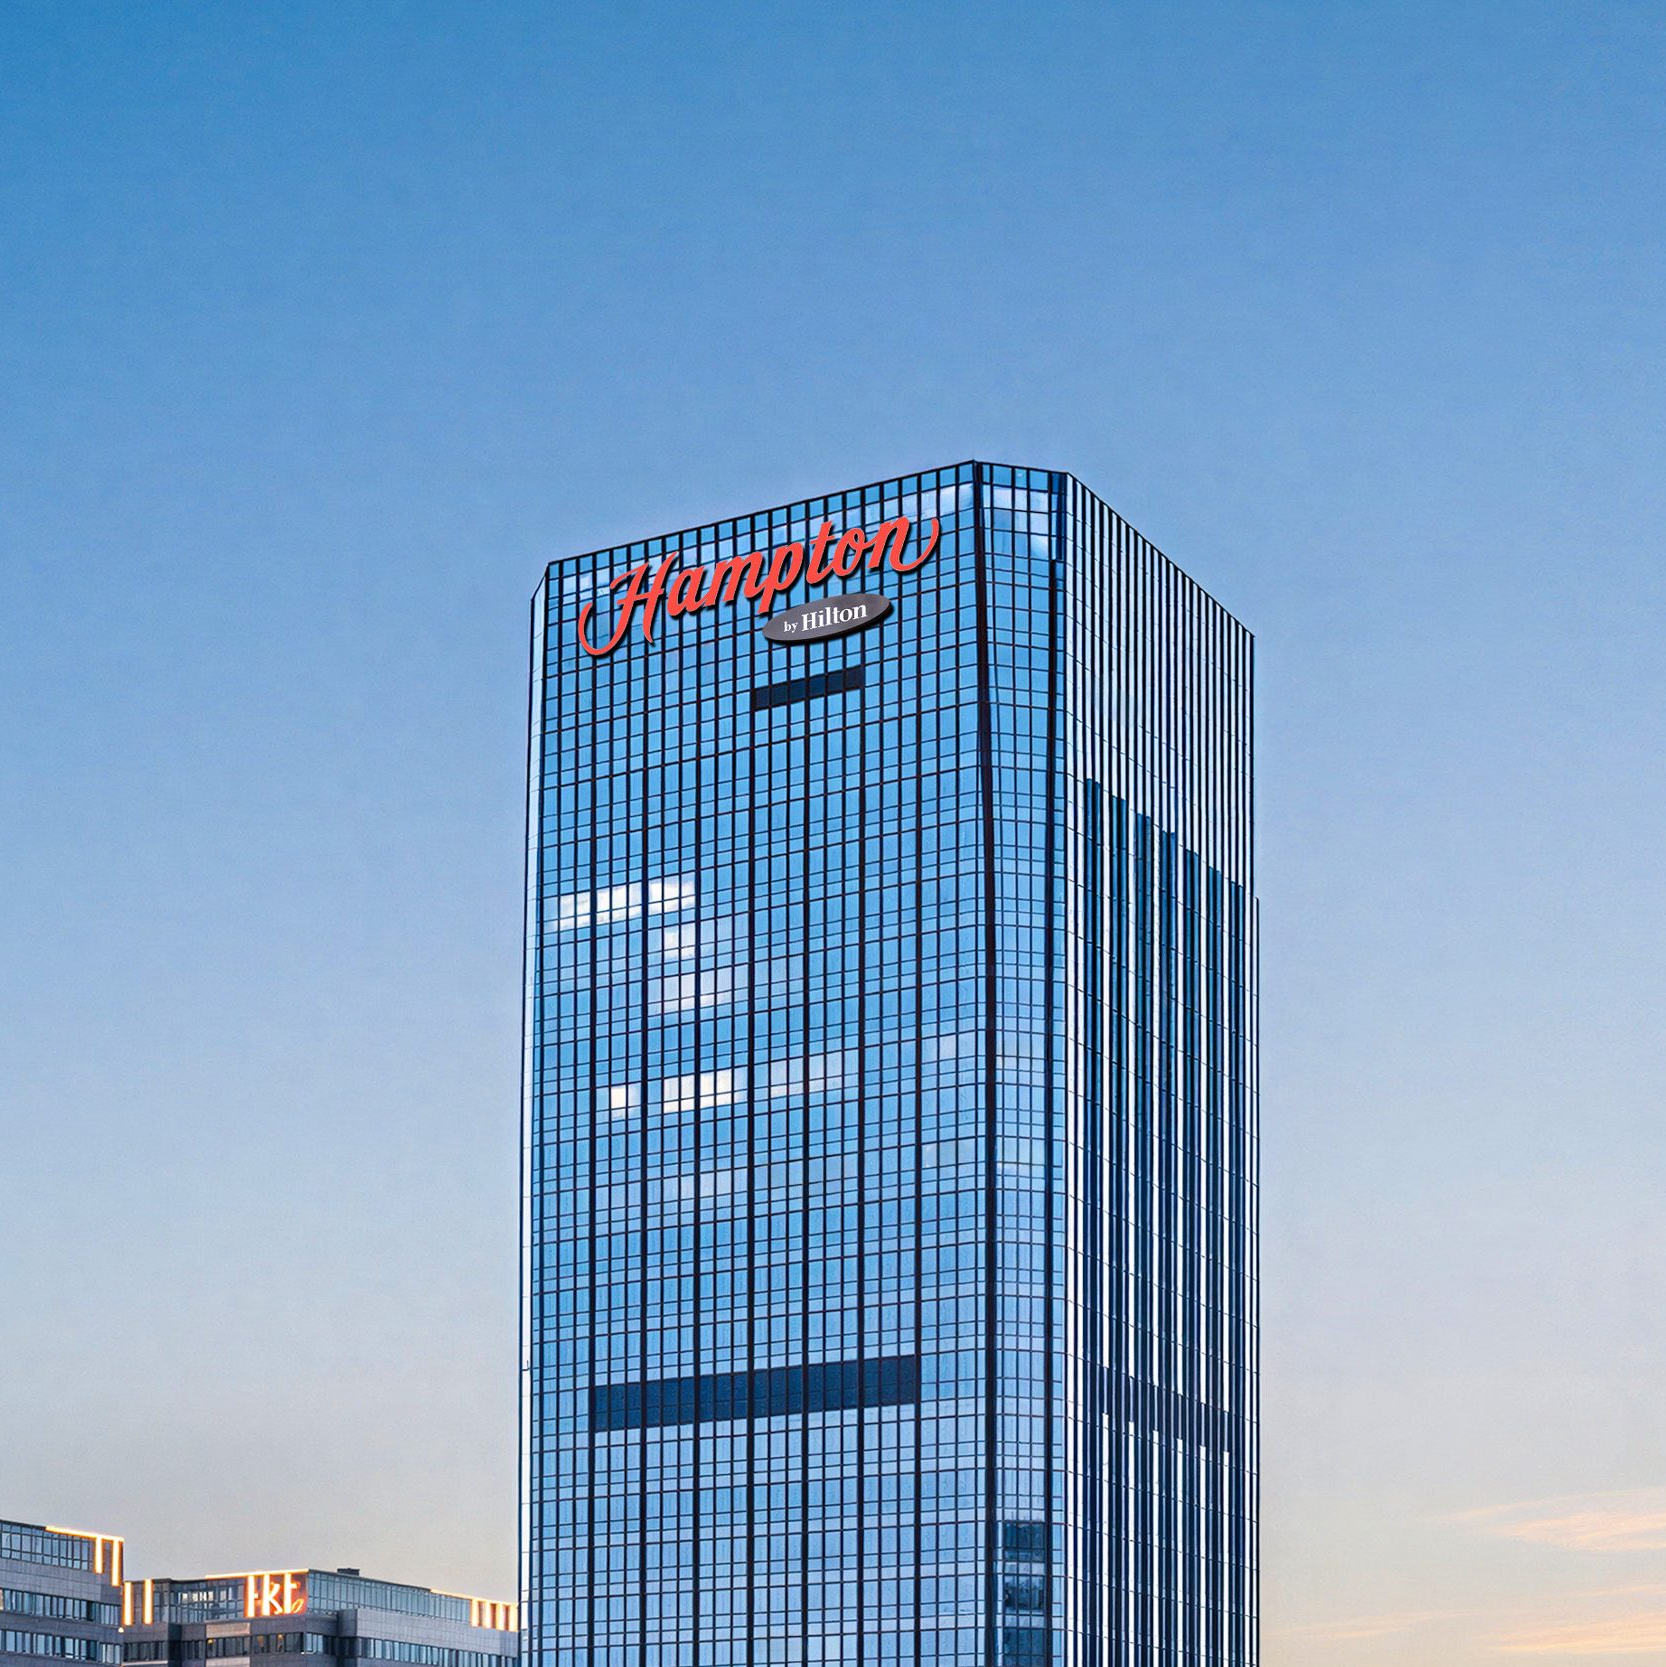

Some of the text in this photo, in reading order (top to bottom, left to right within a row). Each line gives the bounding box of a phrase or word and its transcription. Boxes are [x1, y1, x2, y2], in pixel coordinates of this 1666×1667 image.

[578, 516, 940, 655] Hampton
[783, 604, 868, 634] by Hilton
